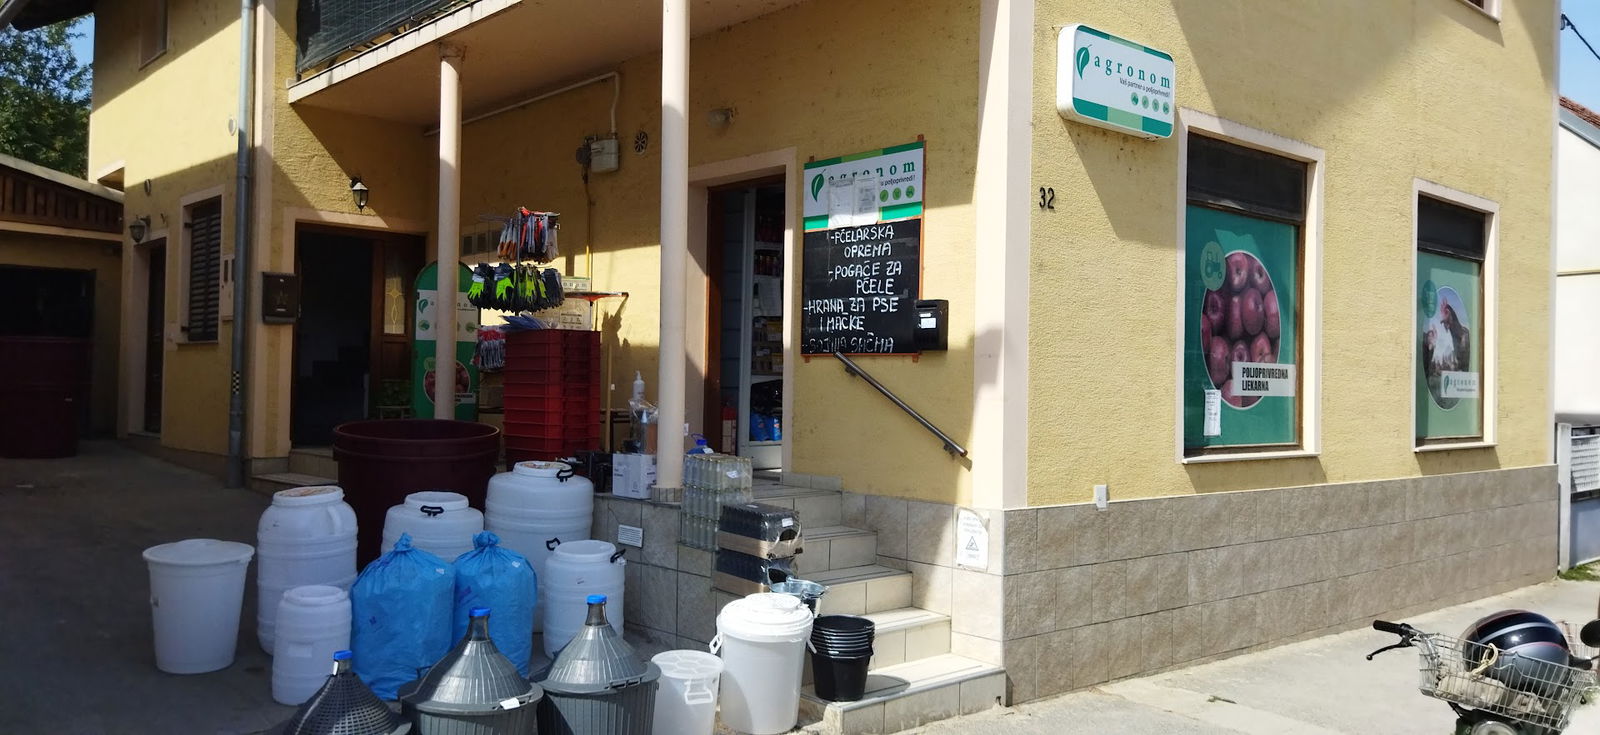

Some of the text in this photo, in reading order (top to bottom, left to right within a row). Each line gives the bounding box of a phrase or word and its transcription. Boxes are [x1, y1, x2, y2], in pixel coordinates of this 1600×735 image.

[1094, 55, 1170, 88] agronom
[1039, 187, 1055, 209] 32
[844, 242, 892, 258] OPREMA
[886, 261, 902, 276] ZA
[856, 277, 894, 295] PČELE
[849, 297, 865, 312] ZA
[873, 297, 899, 312] PSE
[827, 312, 865, 332] MAČKE
[1242, 367, 1288, 379] POLJOPRIVREDNA
[1242, 381, 1269, 391] LJEKARNA
